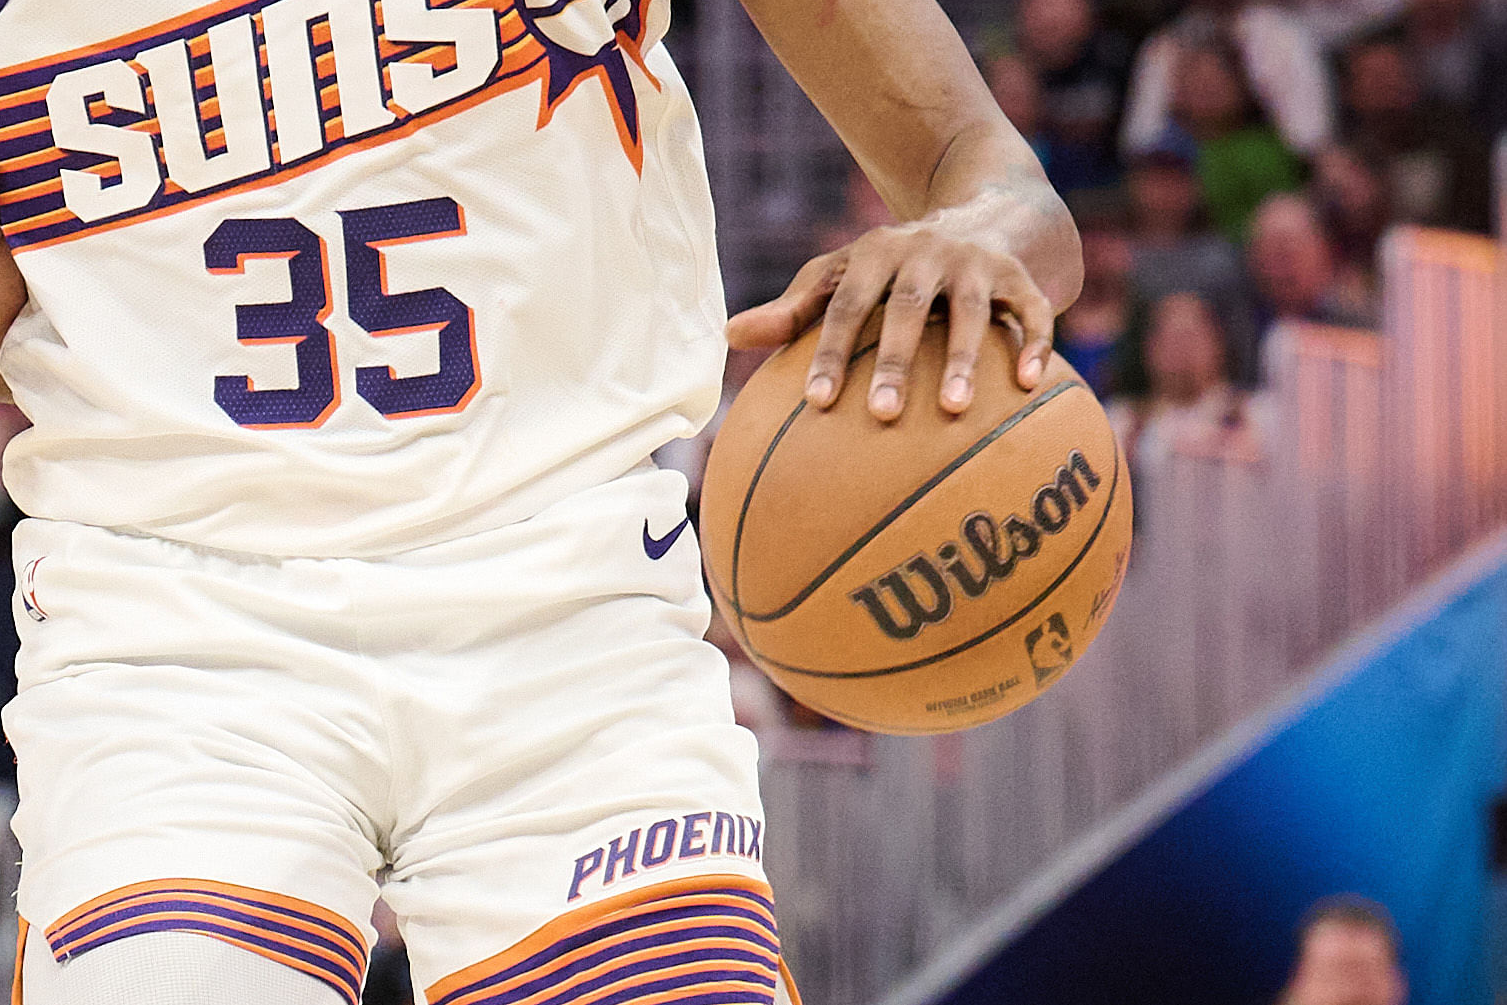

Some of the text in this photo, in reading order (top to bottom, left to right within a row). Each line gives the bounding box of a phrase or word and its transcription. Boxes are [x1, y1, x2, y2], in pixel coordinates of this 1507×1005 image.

[203, 196, 483, 430] 35
[846, 448, 1101, 642] Wilson
[567, 811, 761, 903] PHOENIX
